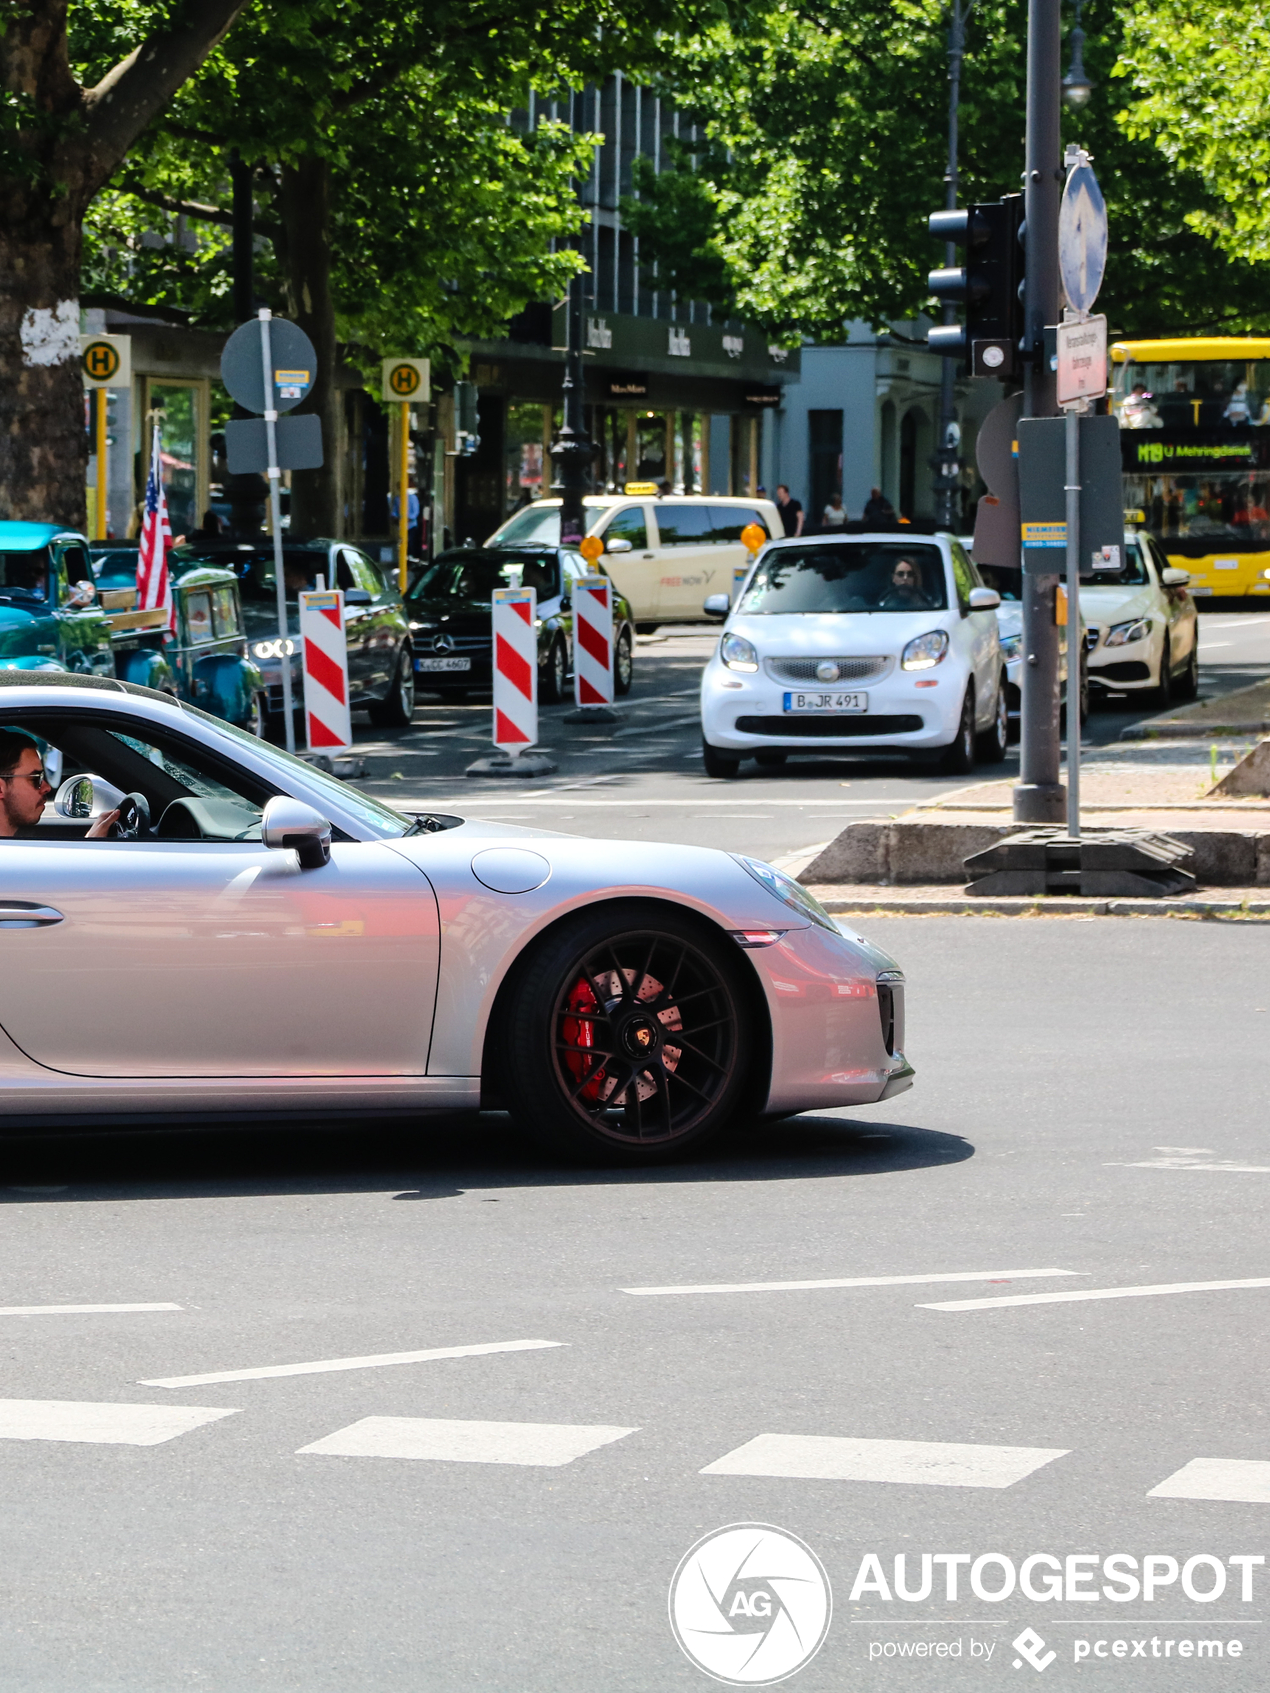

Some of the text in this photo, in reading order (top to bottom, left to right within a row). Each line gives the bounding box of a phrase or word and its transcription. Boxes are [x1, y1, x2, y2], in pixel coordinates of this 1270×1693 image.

[797, 695, 859, 708] B JR 491
